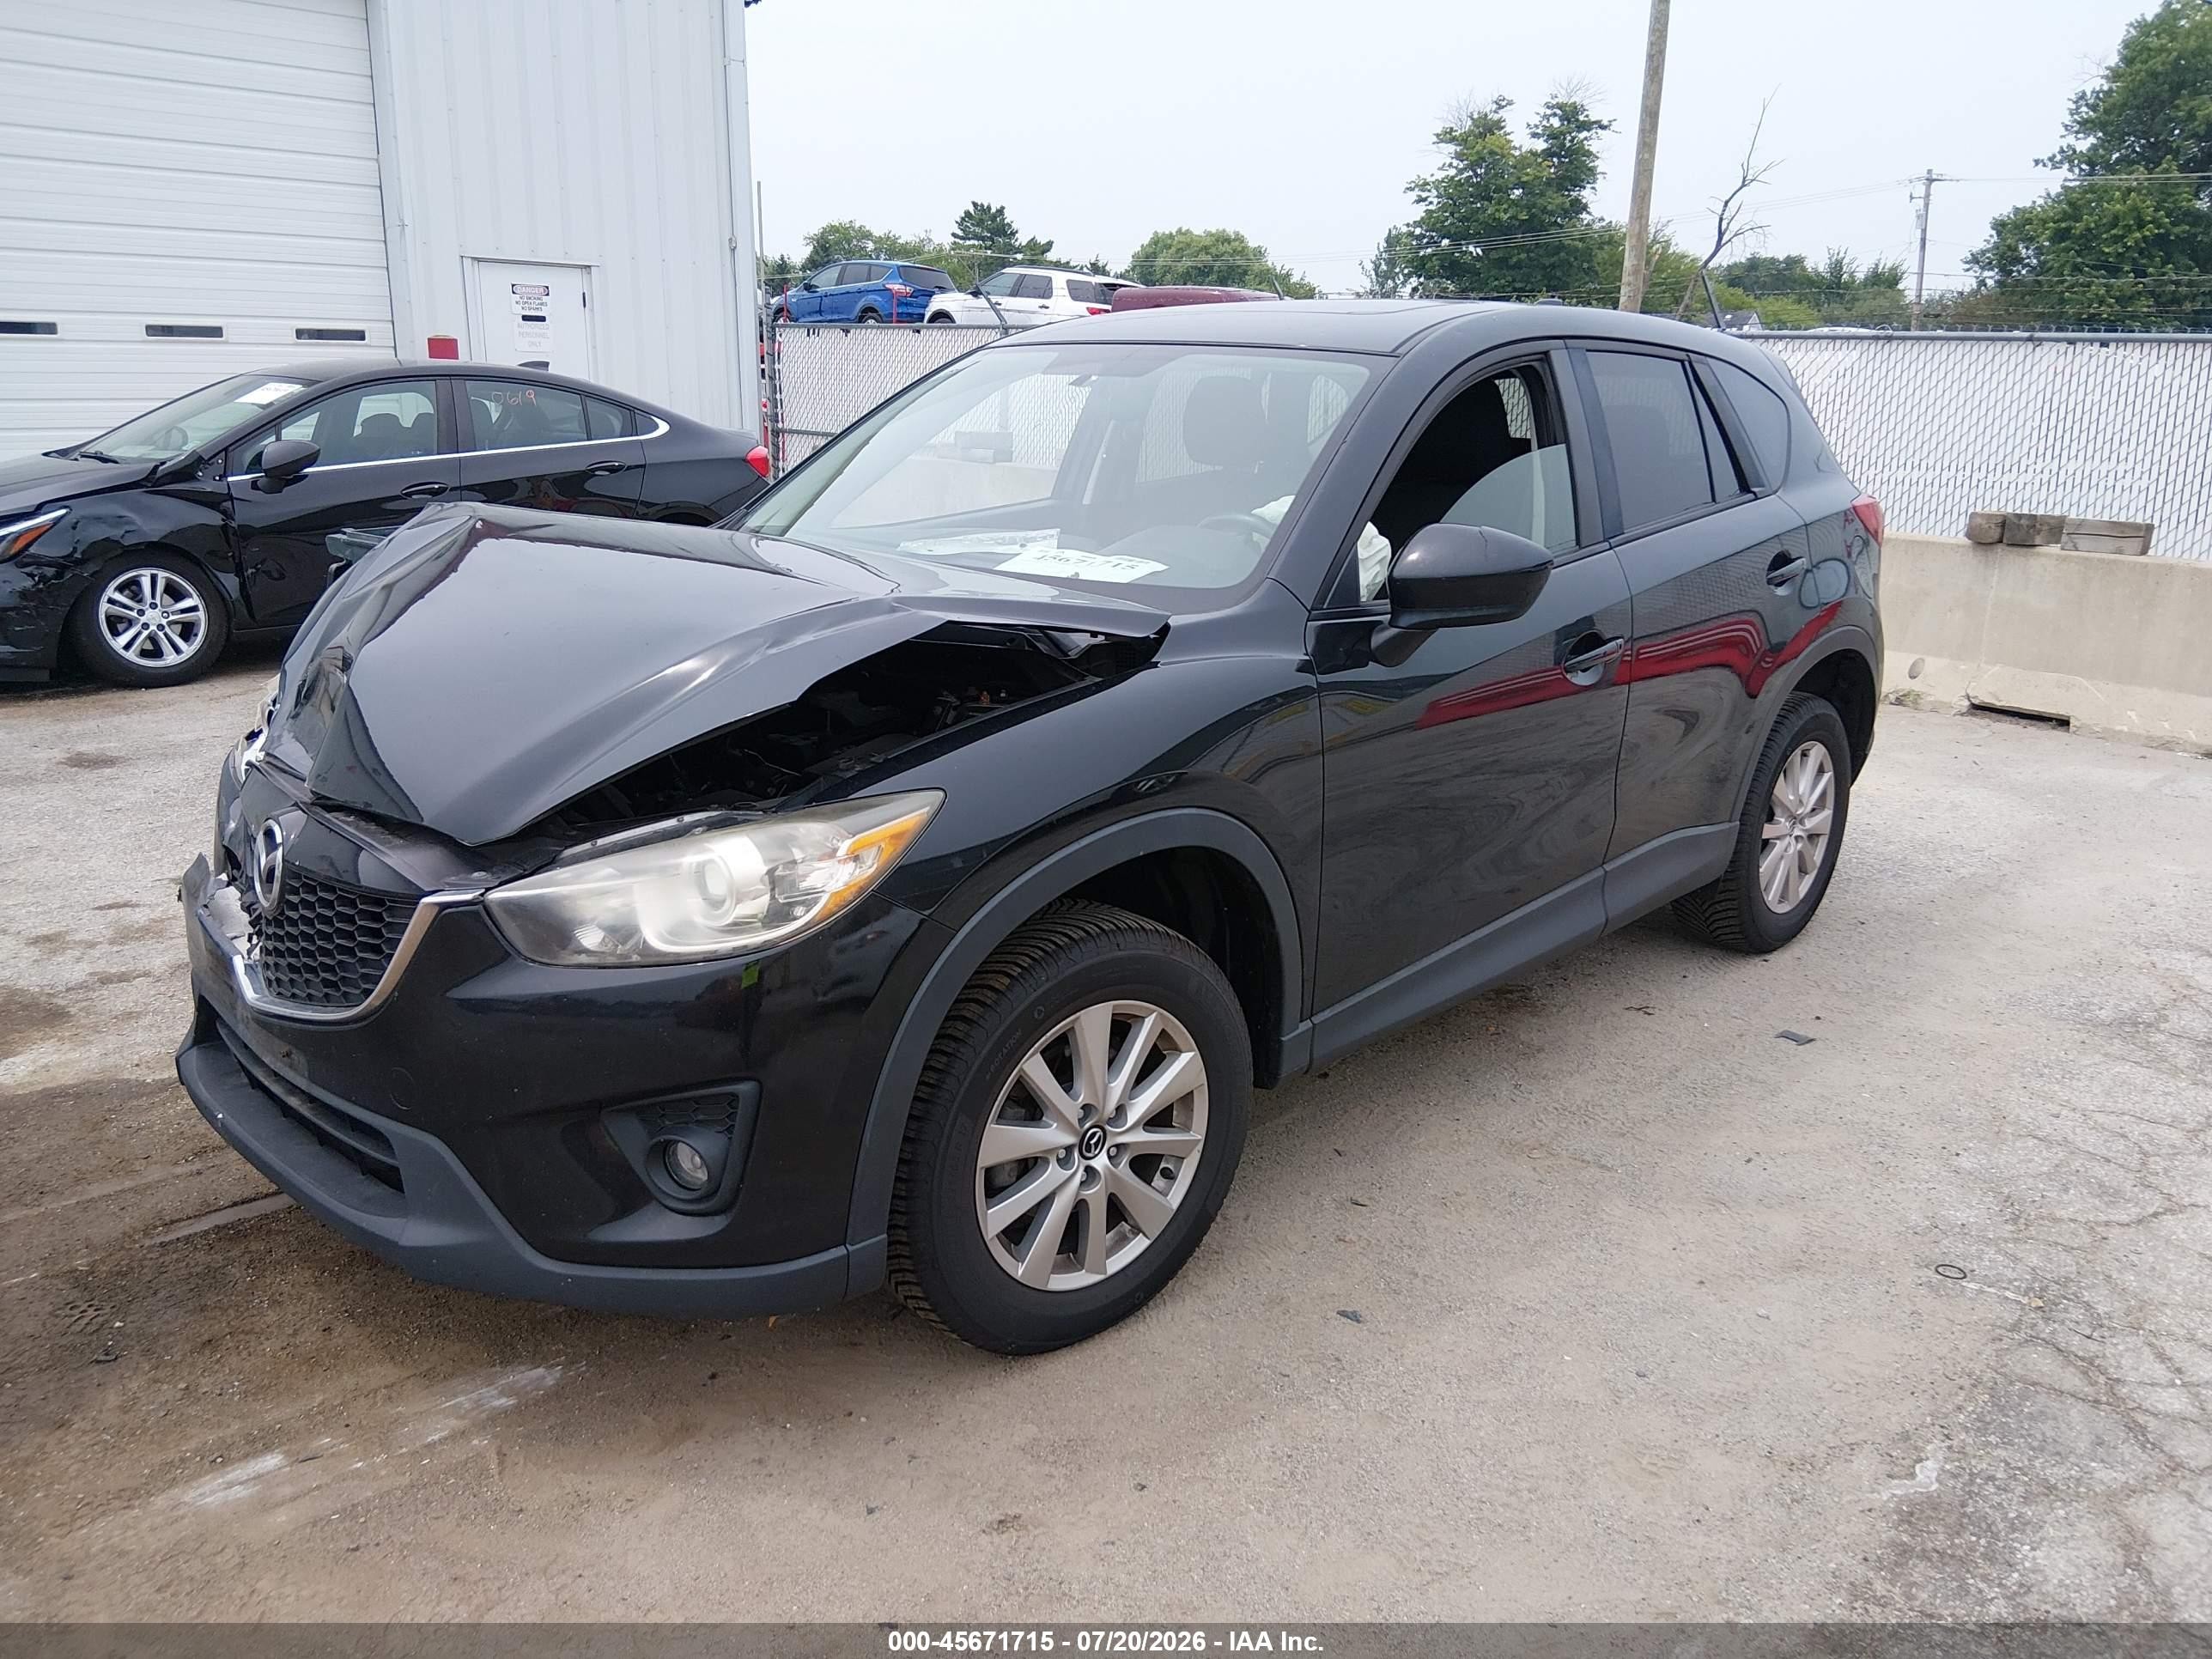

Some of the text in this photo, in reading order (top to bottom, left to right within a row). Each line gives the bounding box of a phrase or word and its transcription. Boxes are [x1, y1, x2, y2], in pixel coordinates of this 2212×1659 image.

[517, 286, 544, 295] DANGER
[517, 322, 550, 331] AUTHORIZED
[518, 331, 550, 339] PERSONNEL
[528, 340, 542, 349] ONLY
[491, 389, 537, 406] 0619
